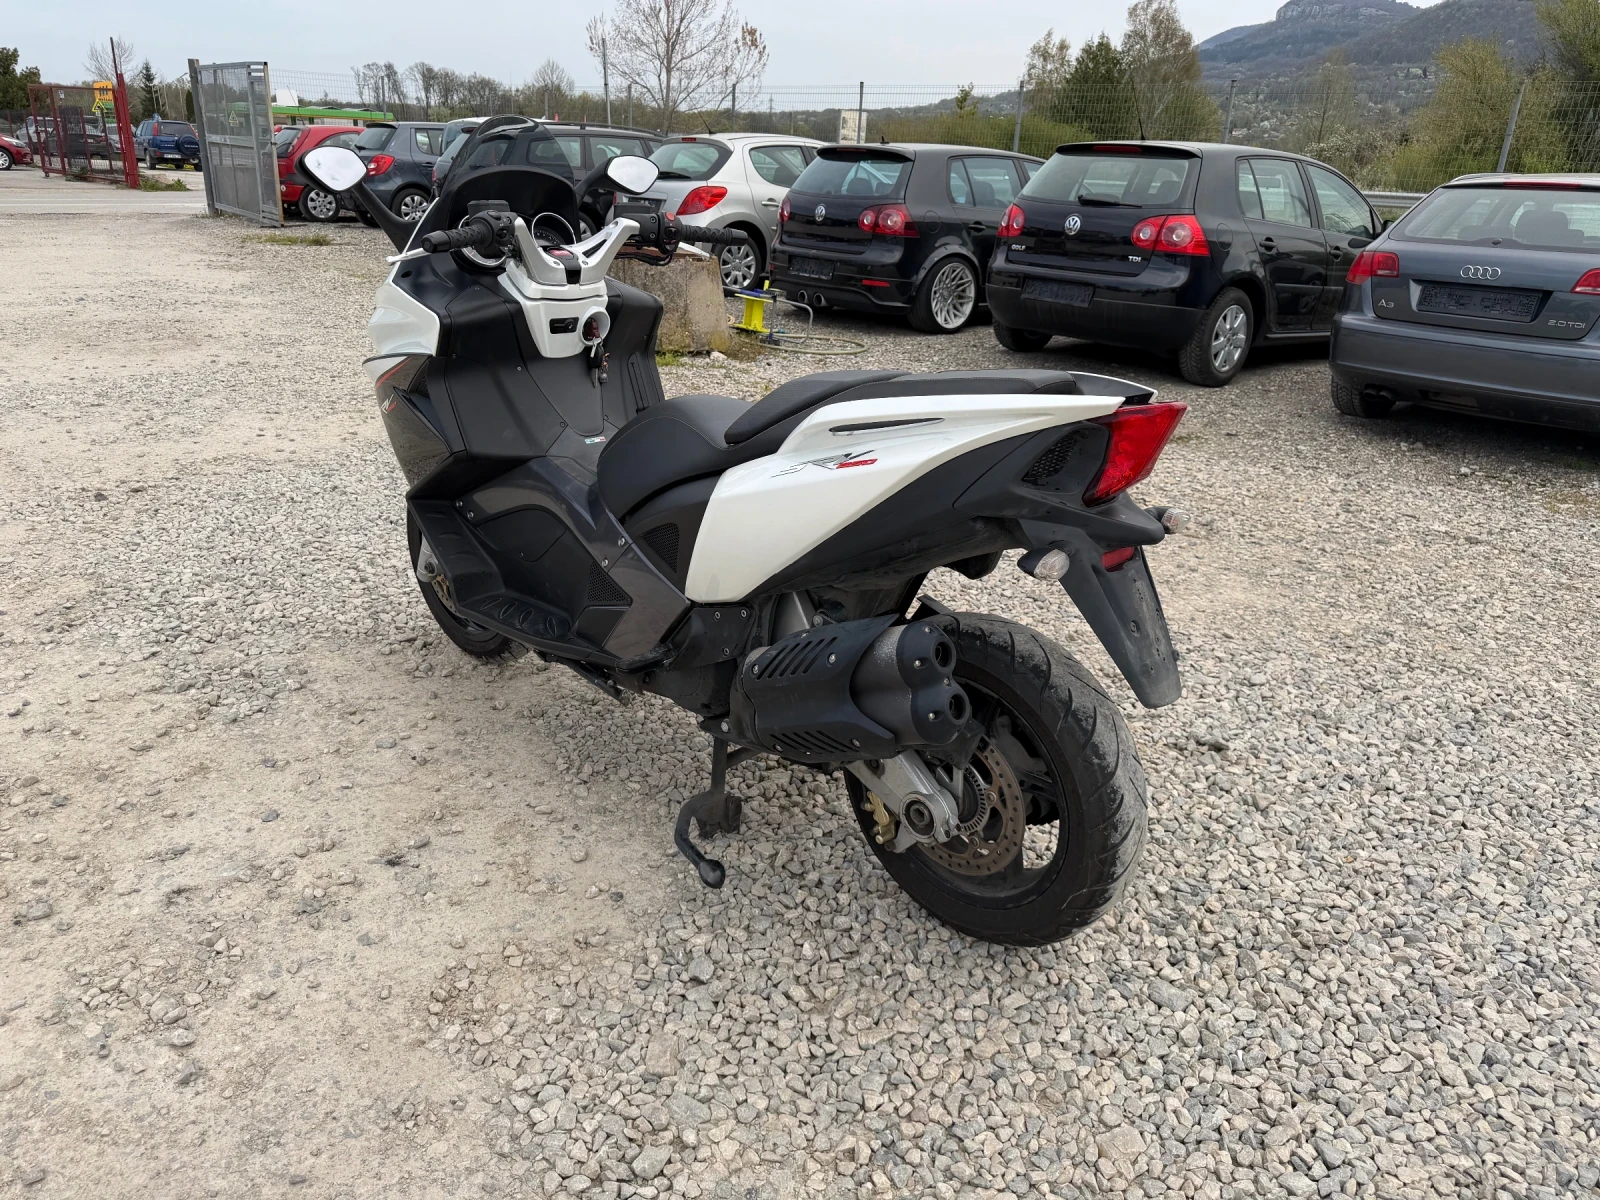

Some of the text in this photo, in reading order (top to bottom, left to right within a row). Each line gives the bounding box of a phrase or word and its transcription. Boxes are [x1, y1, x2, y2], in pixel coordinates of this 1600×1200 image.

[1128, 255, 1142, 263] TDI
[1377, 298, 1395, 308] A3
[1547, 319, 1586, 329] 2.0 TDI
